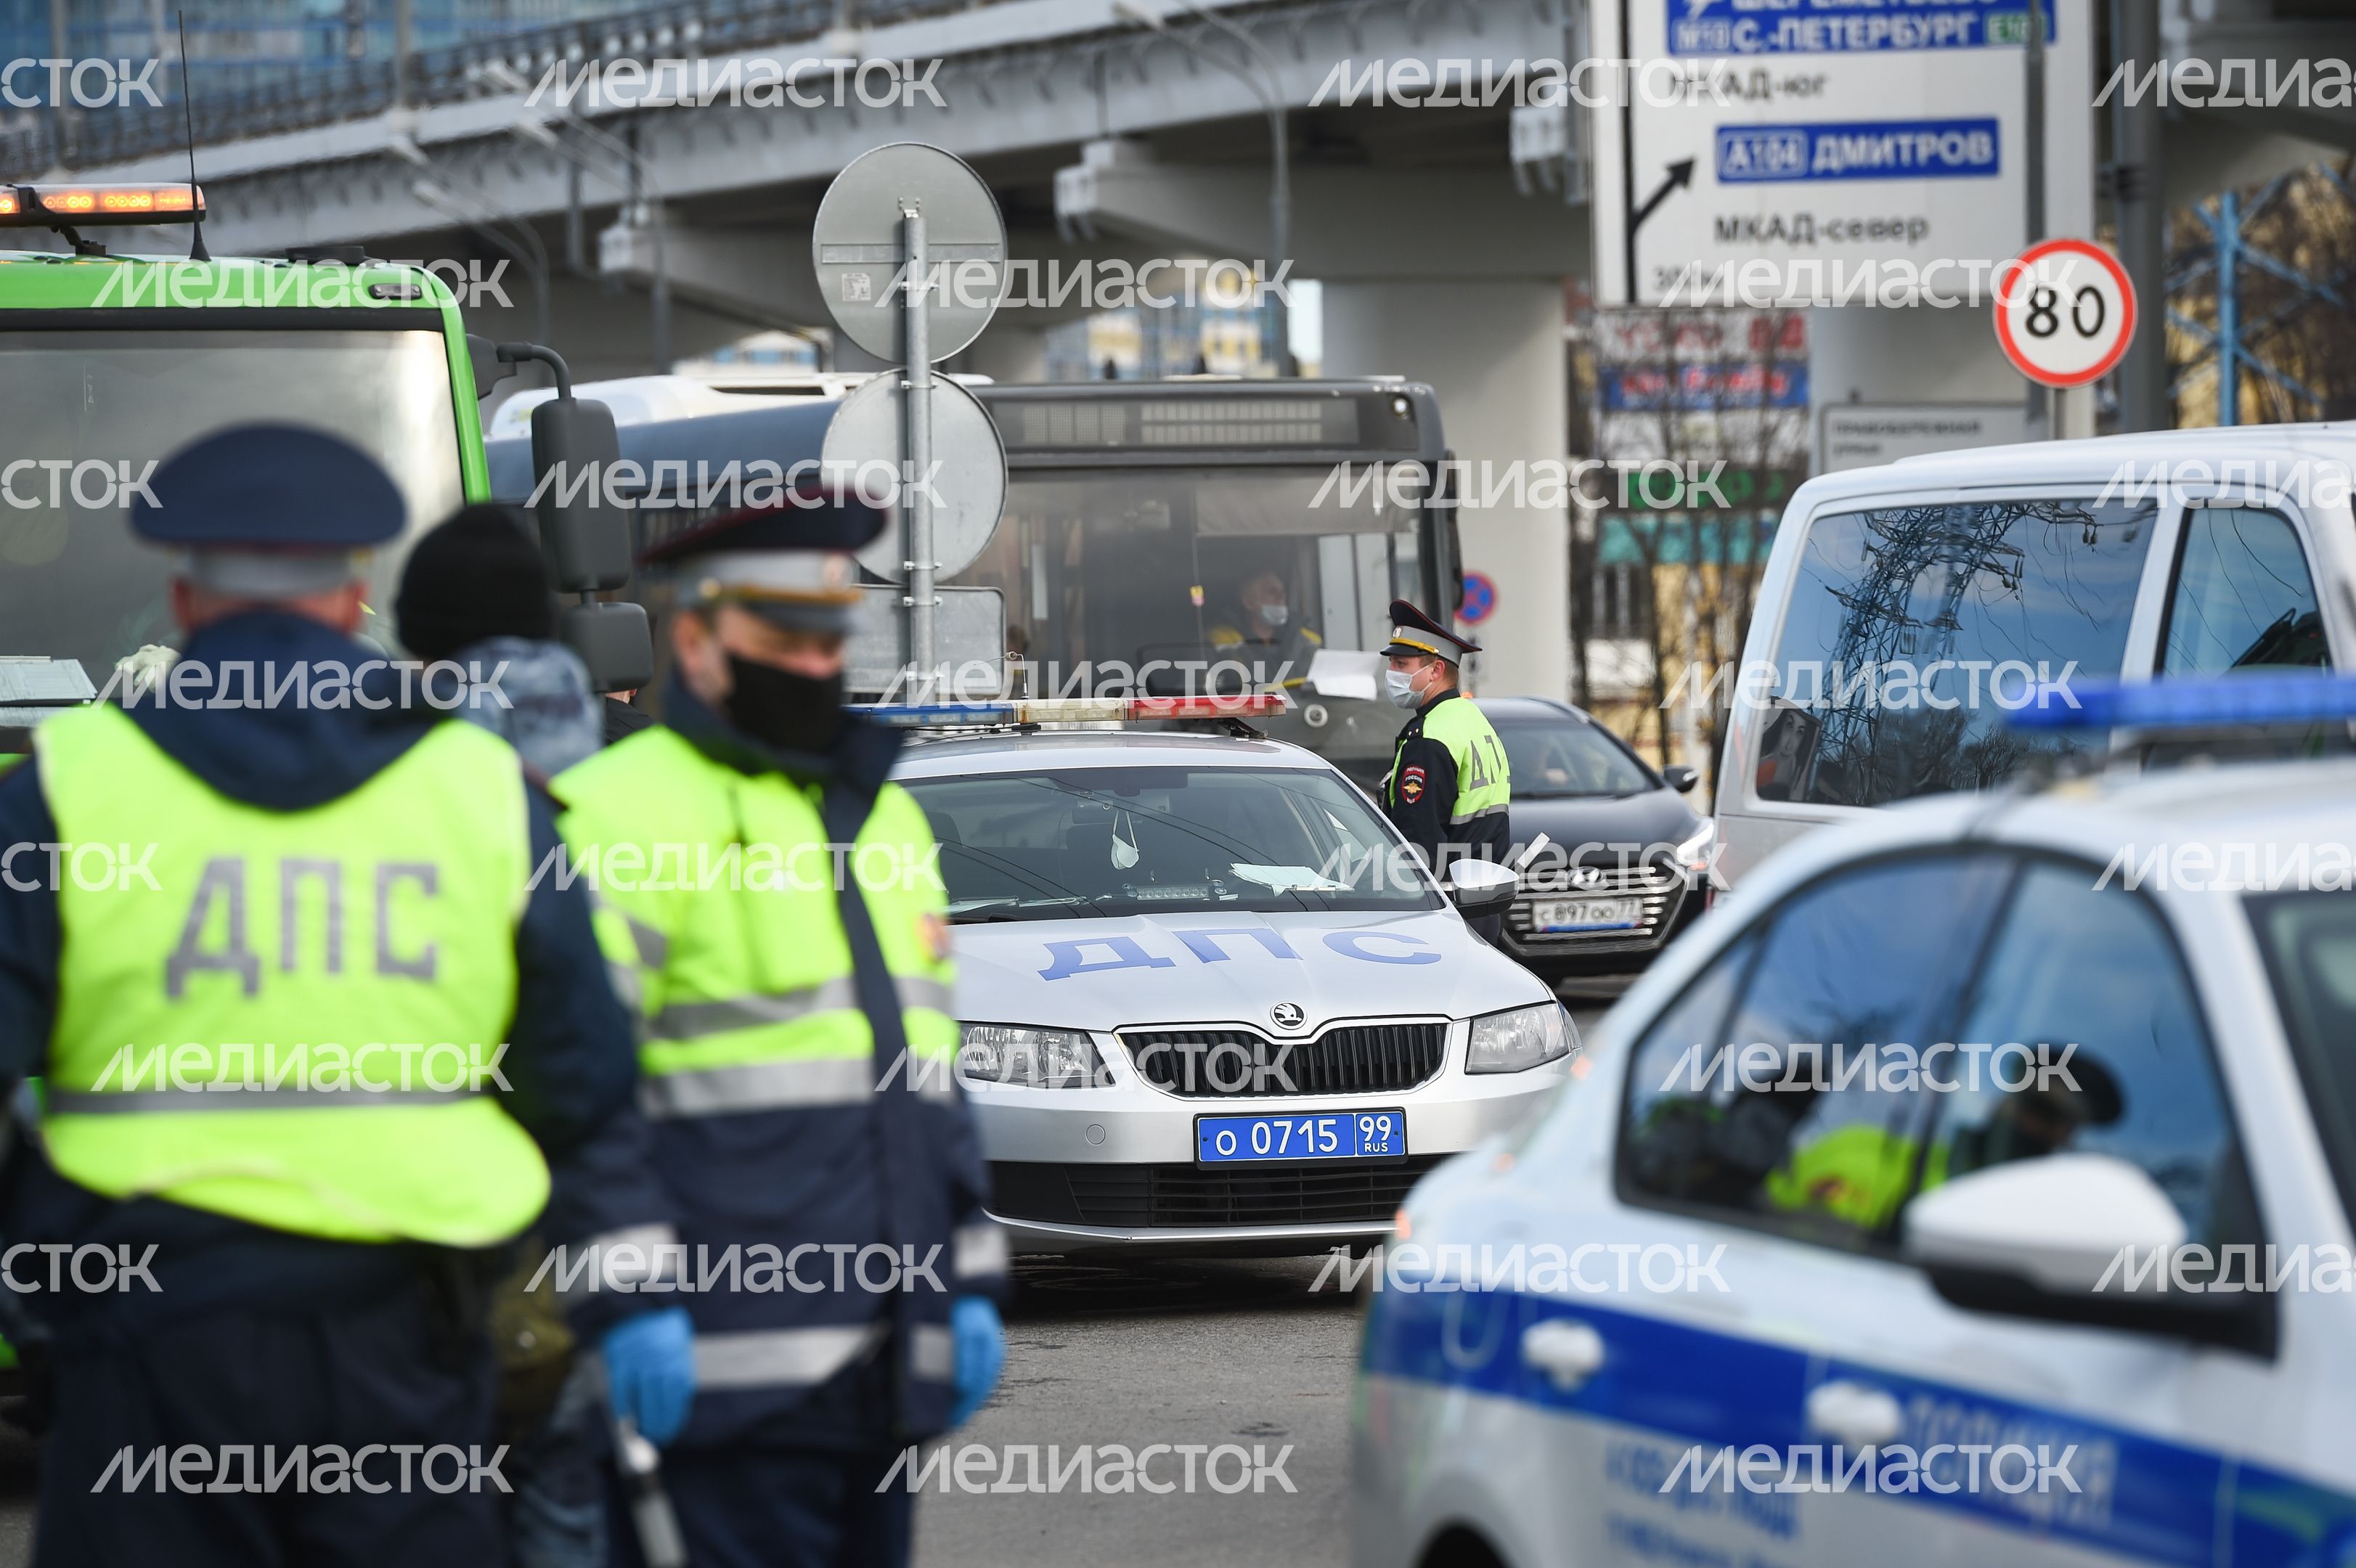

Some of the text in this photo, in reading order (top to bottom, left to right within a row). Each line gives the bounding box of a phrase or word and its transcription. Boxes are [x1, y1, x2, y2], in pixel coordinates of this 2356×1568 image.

[1811, 129, 1995, 173] ДМИТРОВ
[1713, 214, 1931, 247] МКАД-север
[2024, 285, 2107, 340] 80
[166, 857, 440, 1000] ДПС
[1037, 928, 1443, 981] ДПС
[1251, 1119, 1337, 1154] 0715
[1359, 1115, 1392, 1142] 99
[1364, 1142, 1388, 1153] RUS
